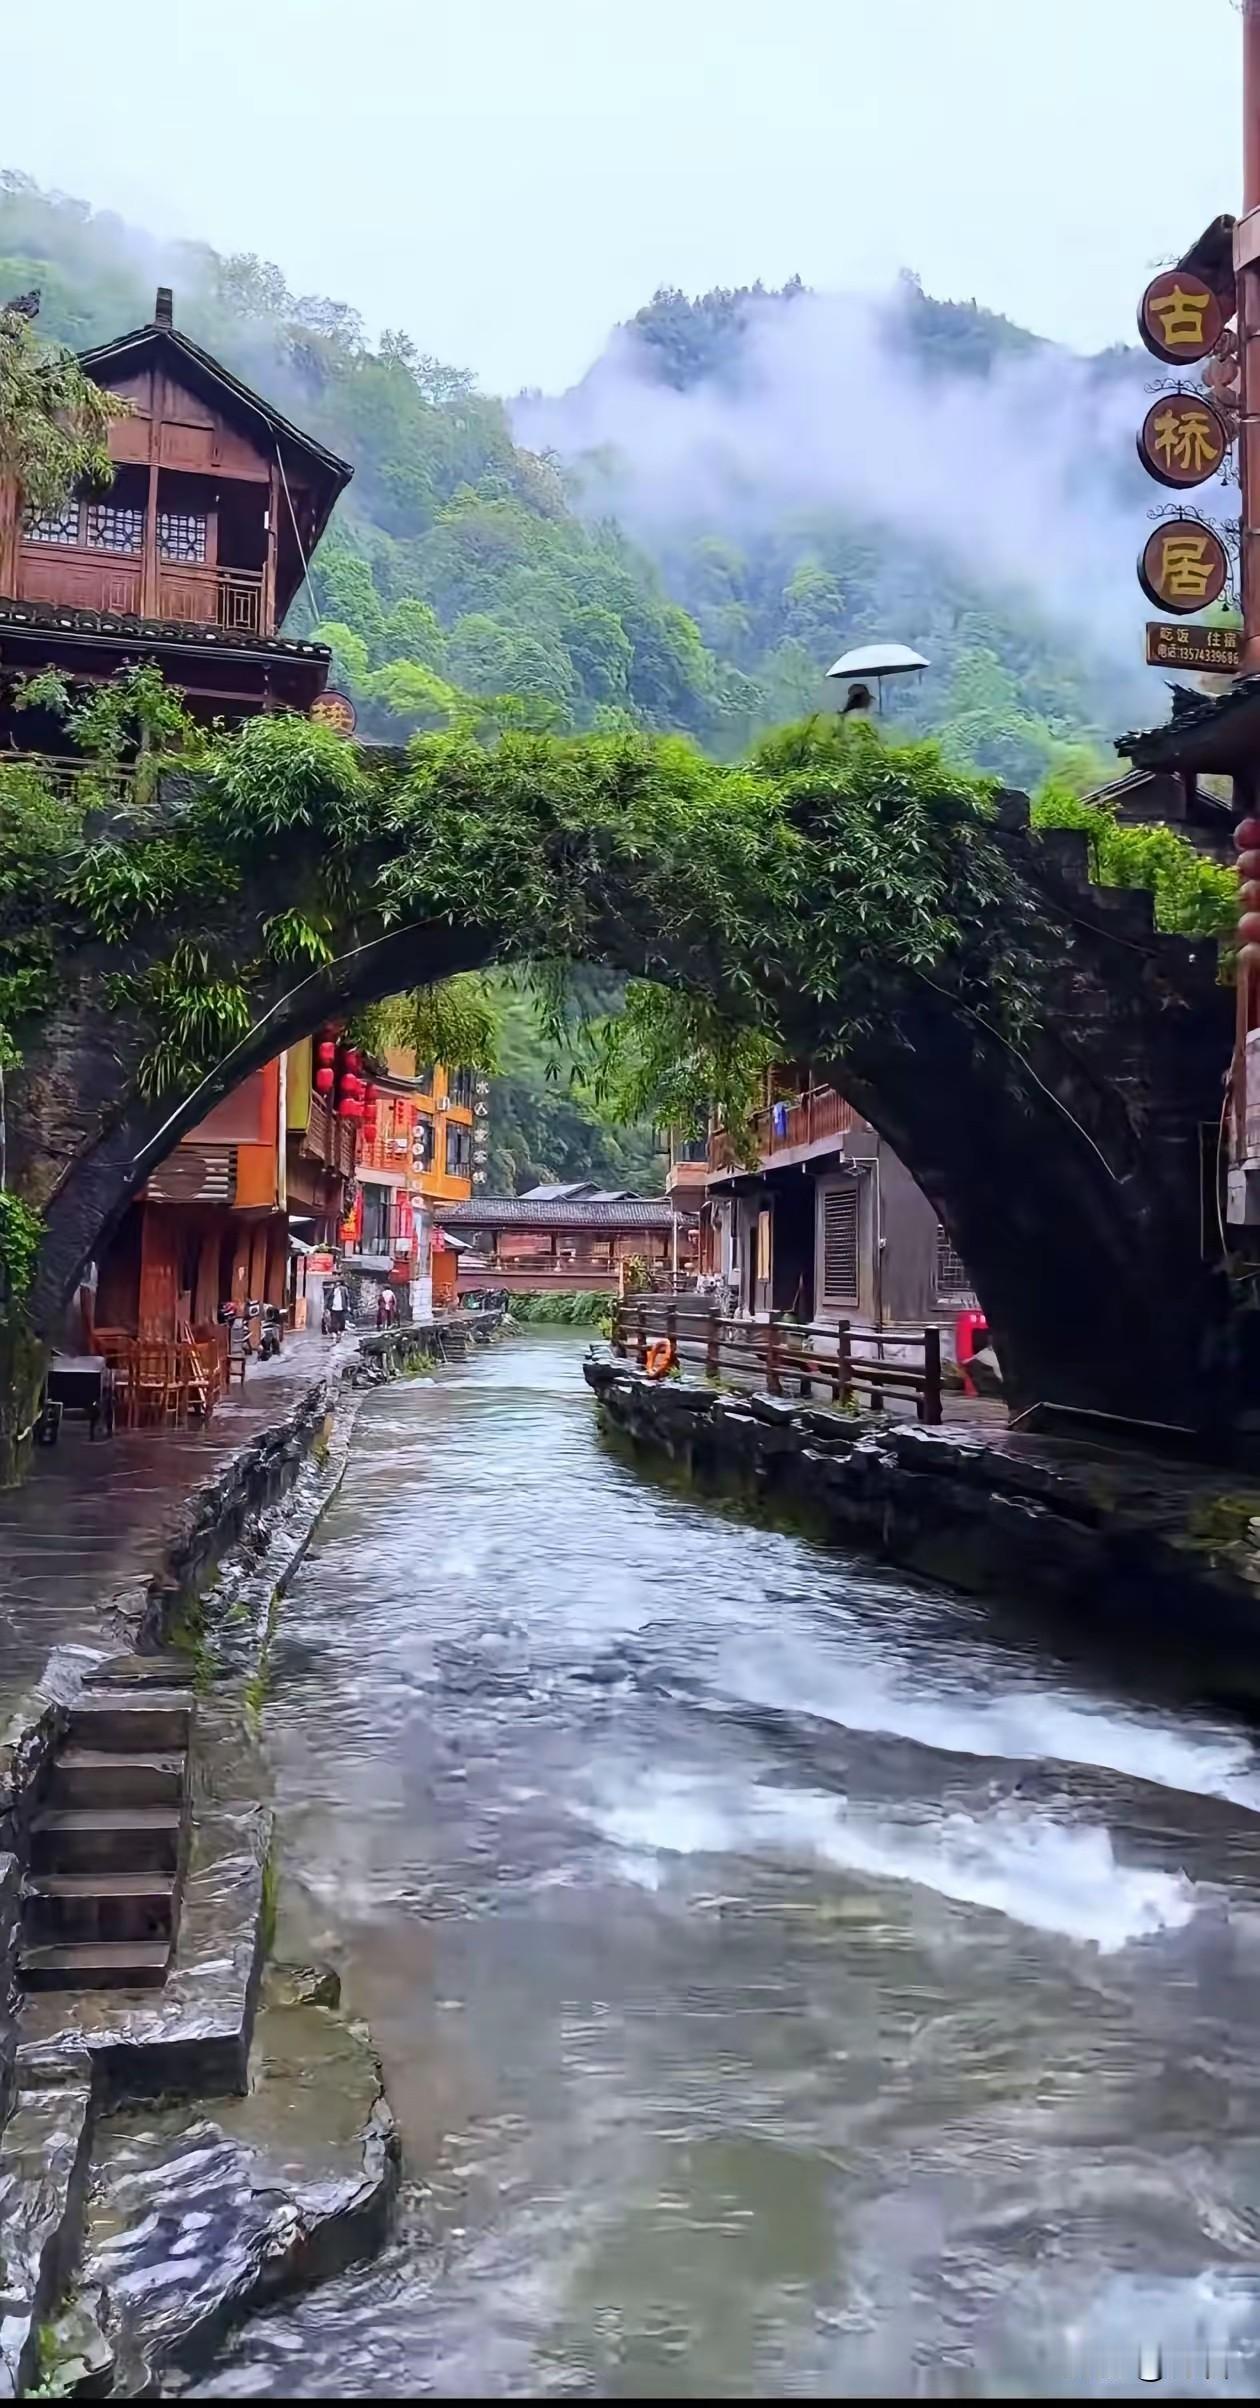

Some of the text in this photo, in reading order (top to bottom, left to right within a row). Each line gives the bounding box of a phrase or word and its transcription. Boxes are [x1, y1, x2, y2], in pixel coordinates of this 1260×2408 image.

[1149, 284, 1217, 595] 古桥居
[1160, 627, 1237, 648] 吃饭 住宿
